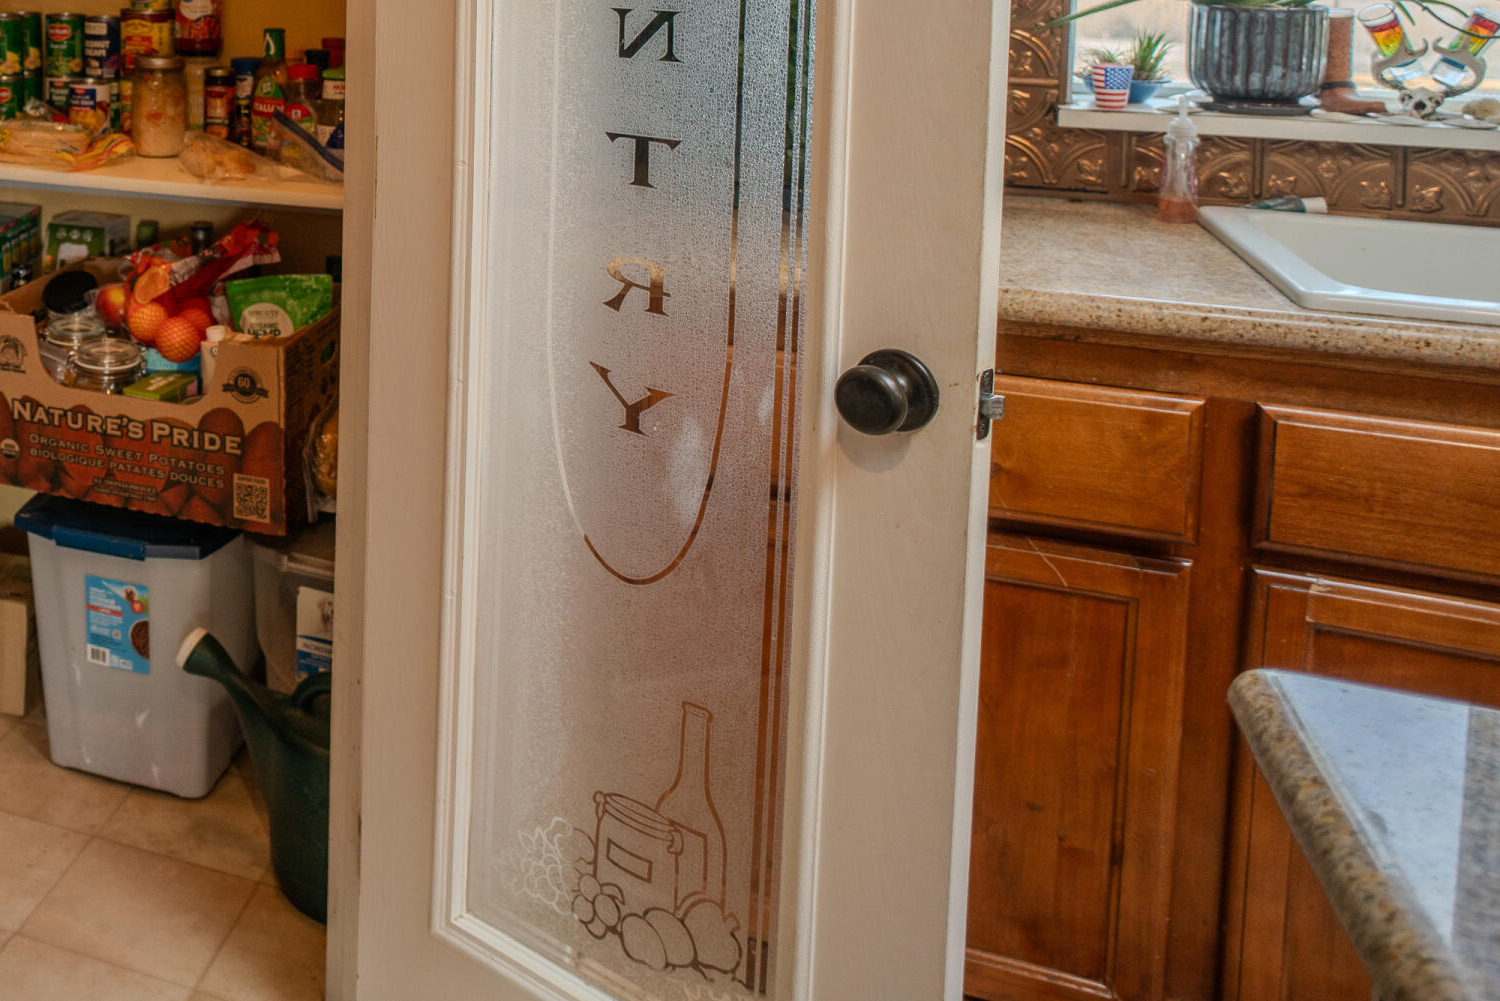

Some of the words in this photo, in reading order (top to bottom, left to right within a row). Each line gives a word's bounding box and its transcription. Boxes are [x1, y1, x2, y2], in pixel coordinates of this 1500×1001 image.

[11, 398, 145, 440] NATURE'S
[151, 421, 242, 456] PRIDE
[28, 433, 90, 453] ORGANIC
[95, 444, 143, 462] SWEET
[148, 453, 226, 476] POTATOES
[30, 447, 105, 468] BIOLOGIQUE
[109, 460, 166, 480] PATATES
[170, 472, 225, 490] DOUCES
